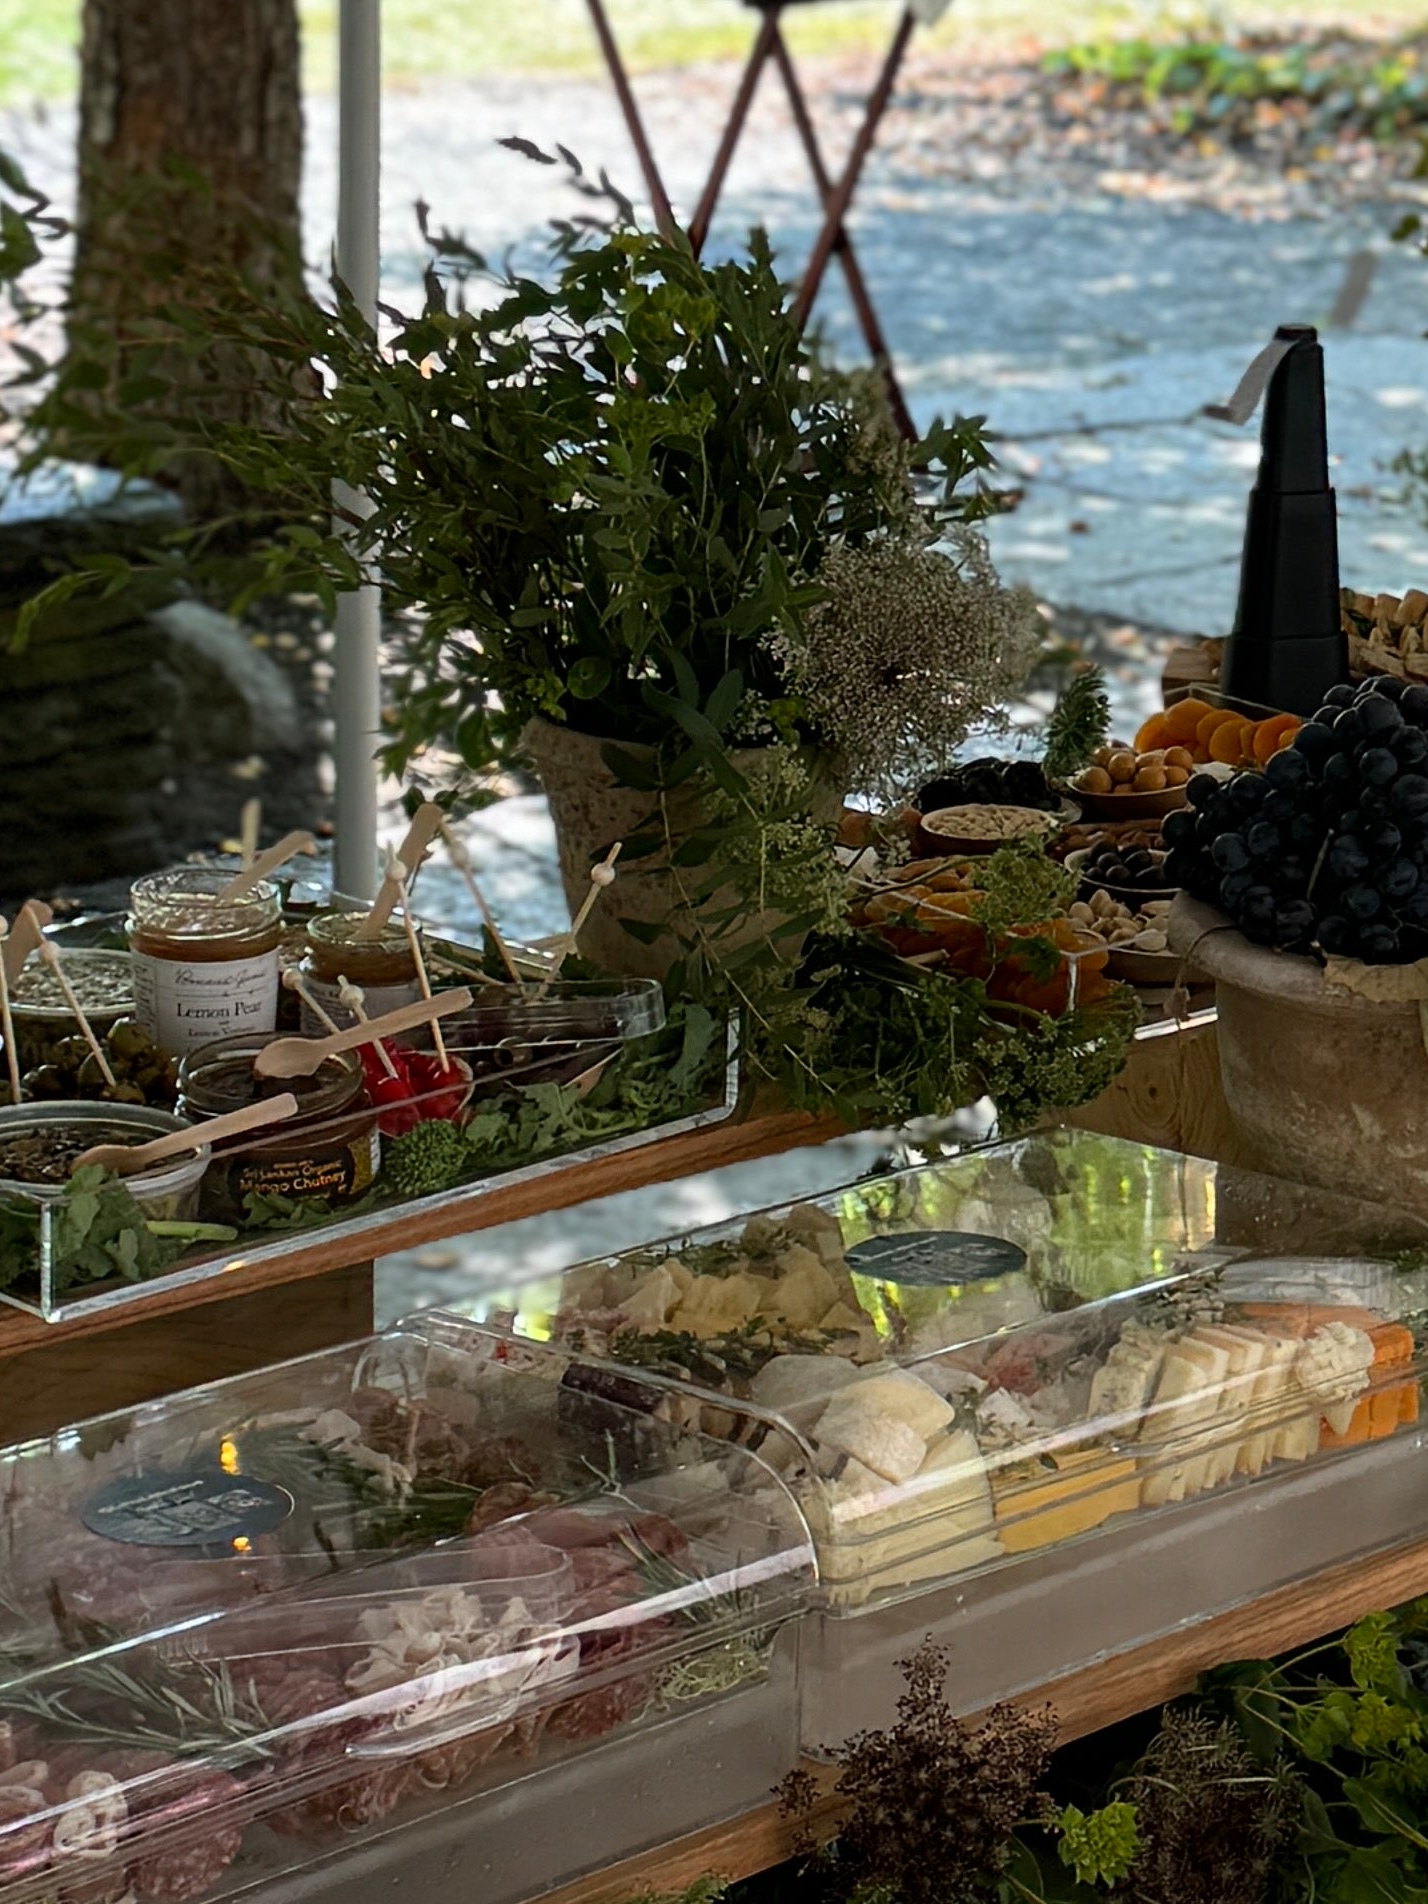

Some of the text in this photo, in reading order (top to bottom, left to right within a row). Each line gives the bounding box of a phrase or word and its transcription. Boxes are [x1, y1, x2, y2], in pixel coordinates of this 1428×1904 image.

[177, 1002, 230, 1018] Lemon
[239, 1170, 346, 1193] Mango Chutney
